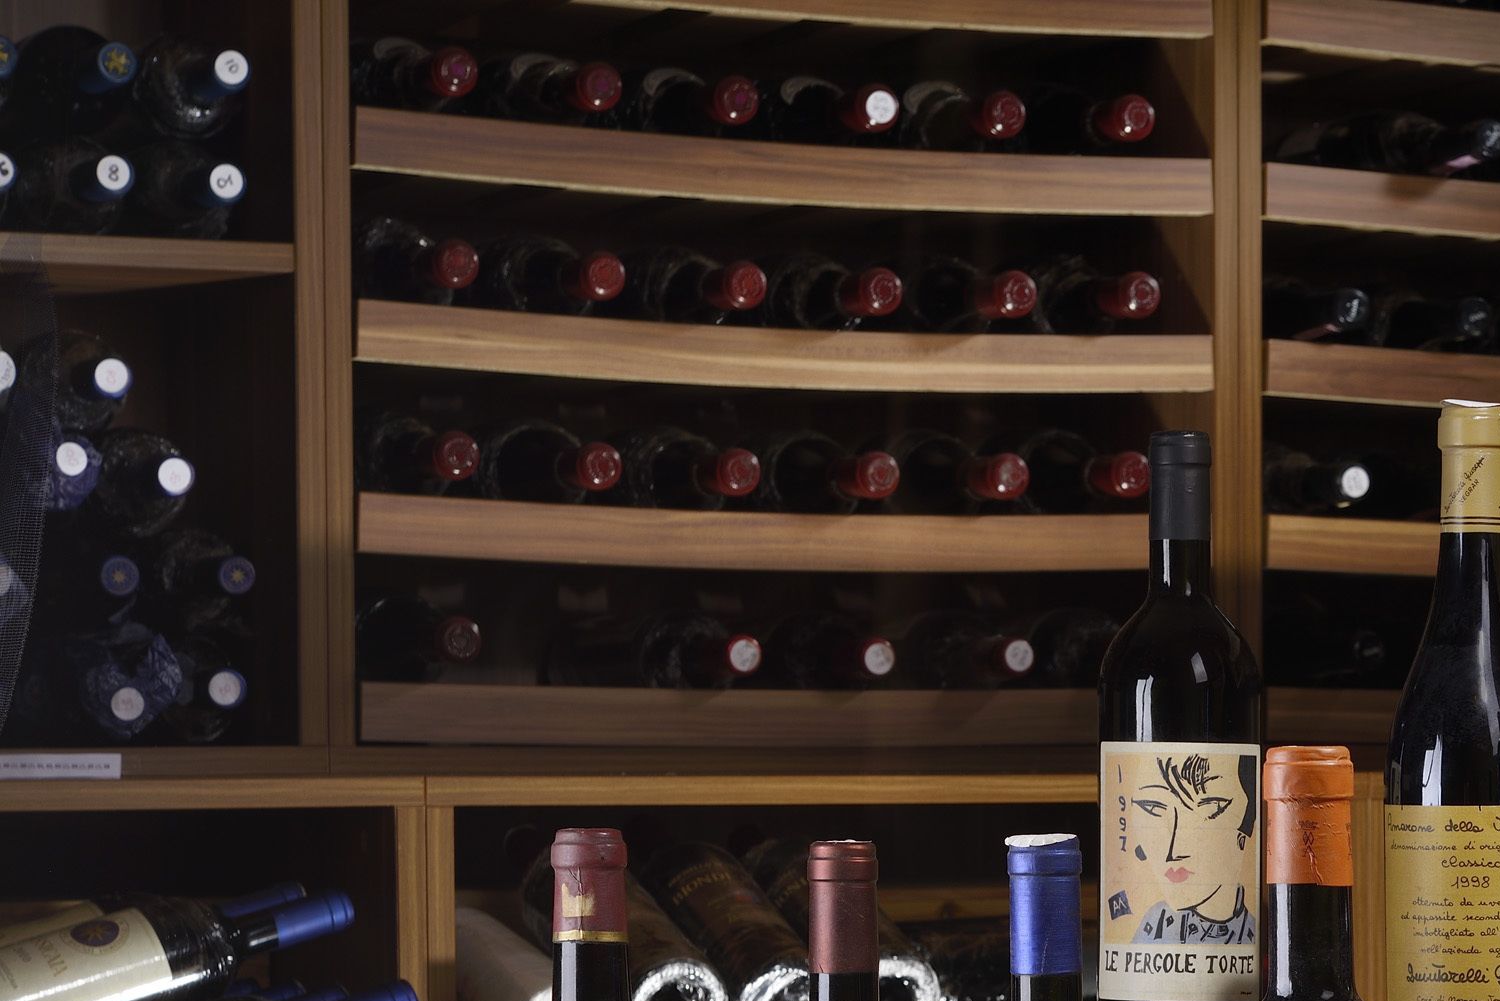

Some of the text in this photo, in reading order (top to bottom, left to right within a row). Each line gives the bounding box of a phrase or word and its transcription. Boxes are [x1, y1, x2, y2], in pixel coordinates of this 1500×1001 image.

[1444, 819, 1484, 833] della
[1463, 840, 1476, 851] di
[1450, 875, 1491, 889] 1998
[1459, 897, 1474, 907] da
[1105, 950, 1254, 974] LE PERGOLE TORTE
